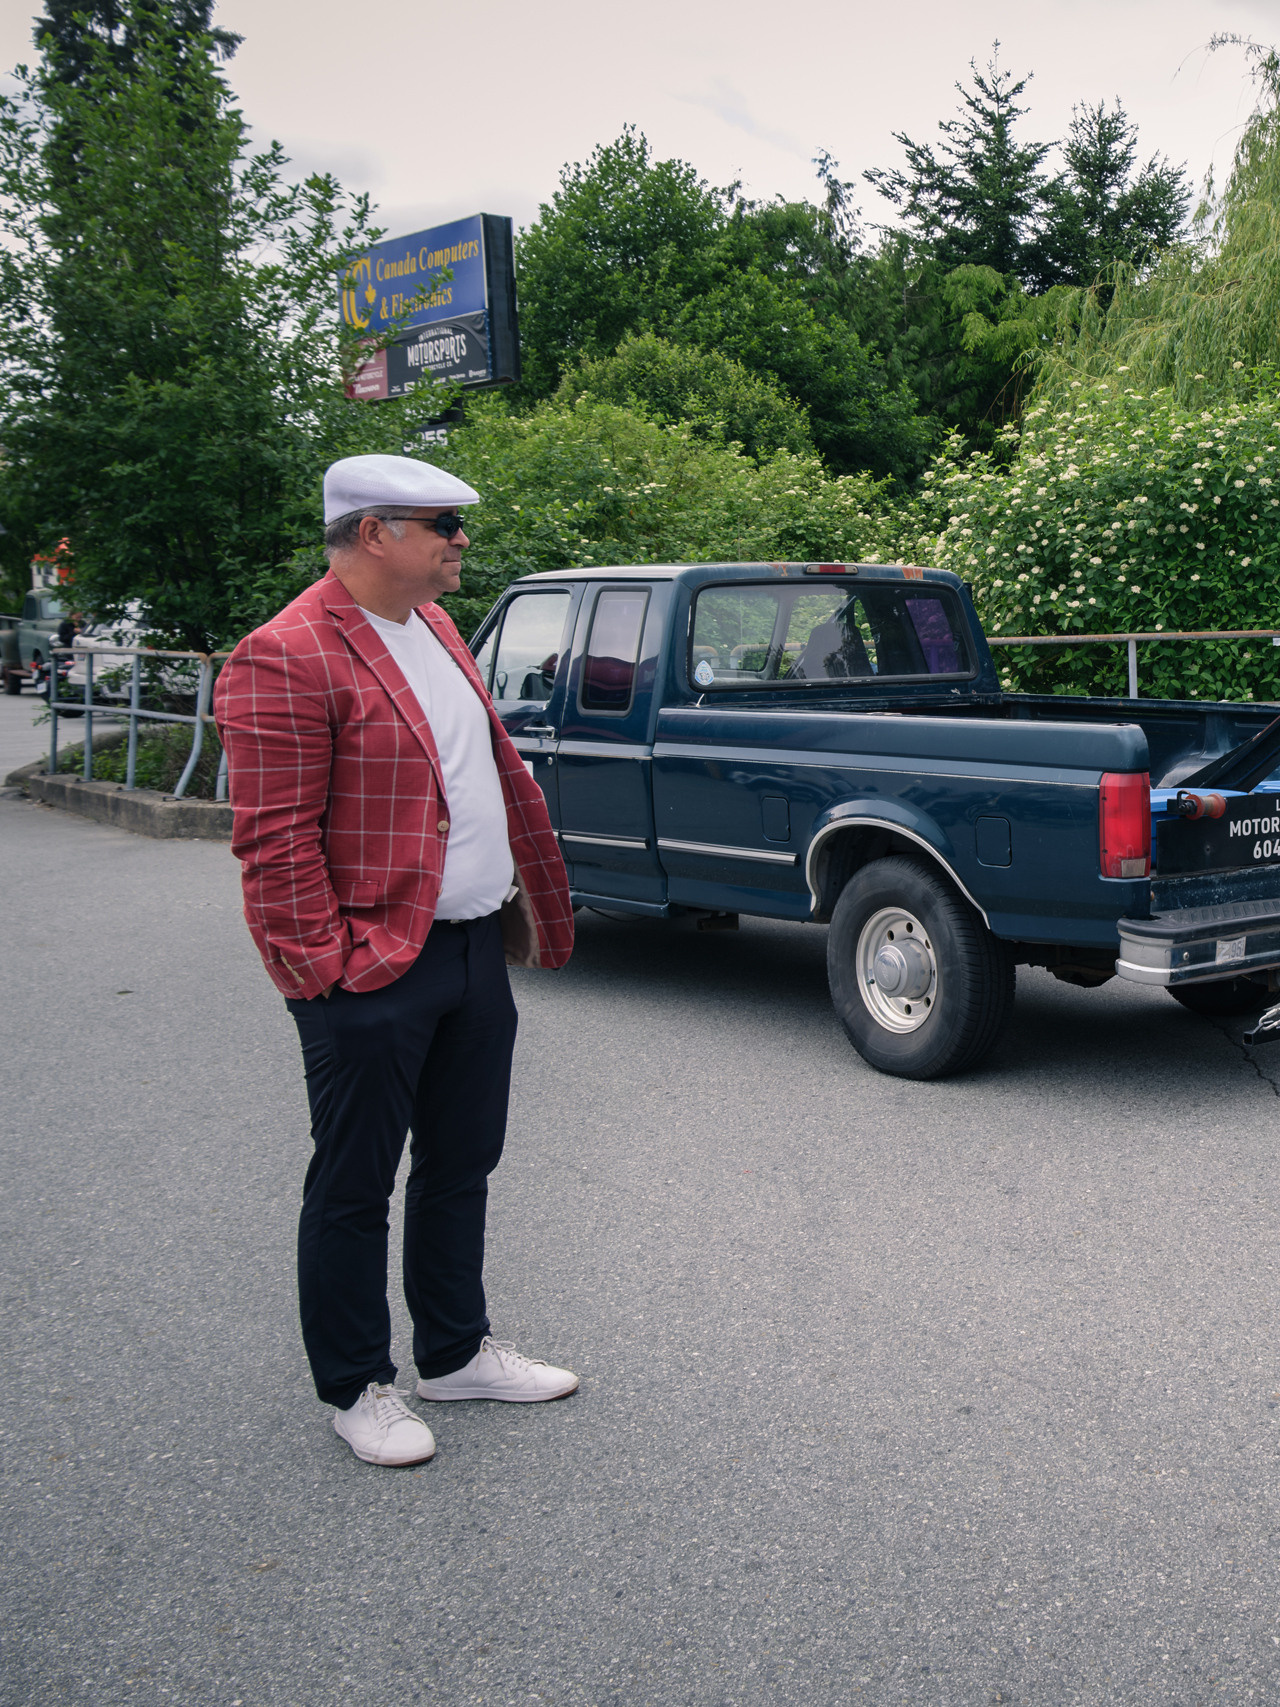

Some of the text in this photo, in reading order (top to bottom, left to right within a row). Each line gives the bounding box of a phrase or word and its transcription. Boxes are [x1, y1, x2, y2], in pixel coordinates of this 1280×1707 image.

[376, 240, 479, 281] Canada Computers
[380, 296, 389, 320] &
[407, 334, 466, 367] MOTORSPORTS
